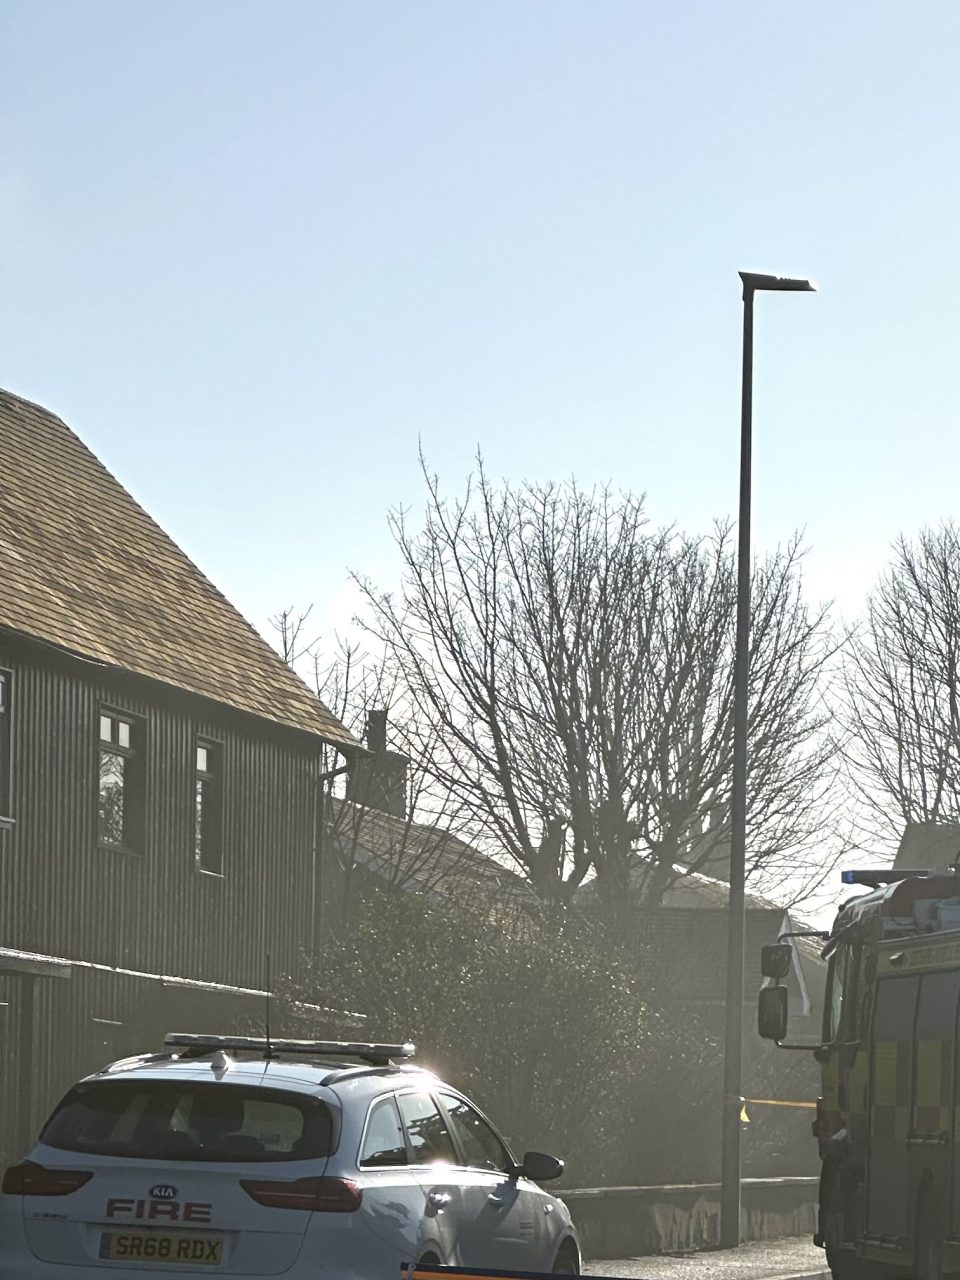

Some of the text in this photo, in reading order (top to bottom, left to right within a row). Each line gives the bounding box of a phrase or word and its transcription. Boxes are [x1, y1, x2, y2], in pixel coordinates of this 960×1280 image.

[152, 1186, 174, 1197] KIA
[105, 1198, 213, 1223] FIRE
[116, 1235, 221, 1261] SR68 RDX
